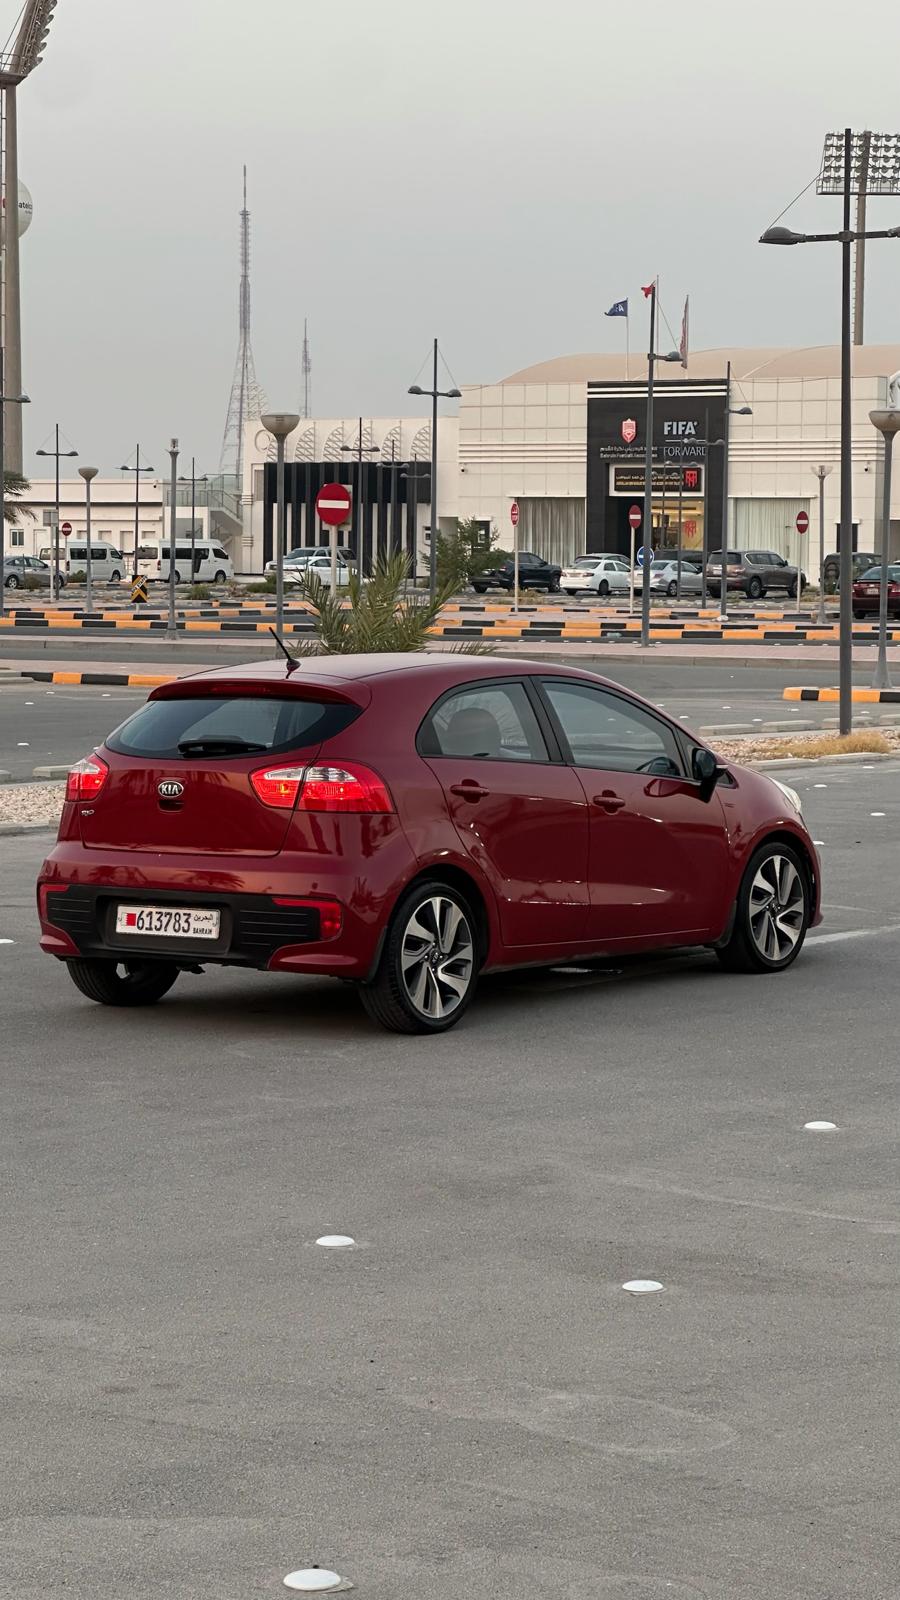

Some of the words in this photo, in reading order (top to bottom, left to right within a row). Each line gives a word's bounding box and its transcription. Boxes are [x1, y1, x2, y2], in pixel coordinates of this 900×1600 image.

[663, 421, 696, 435] FIFA
[161, 784, 179, 795] KIA
[137, 910, 191, 933] 613783
[193, 927, 213, 935] BAHRAIN
